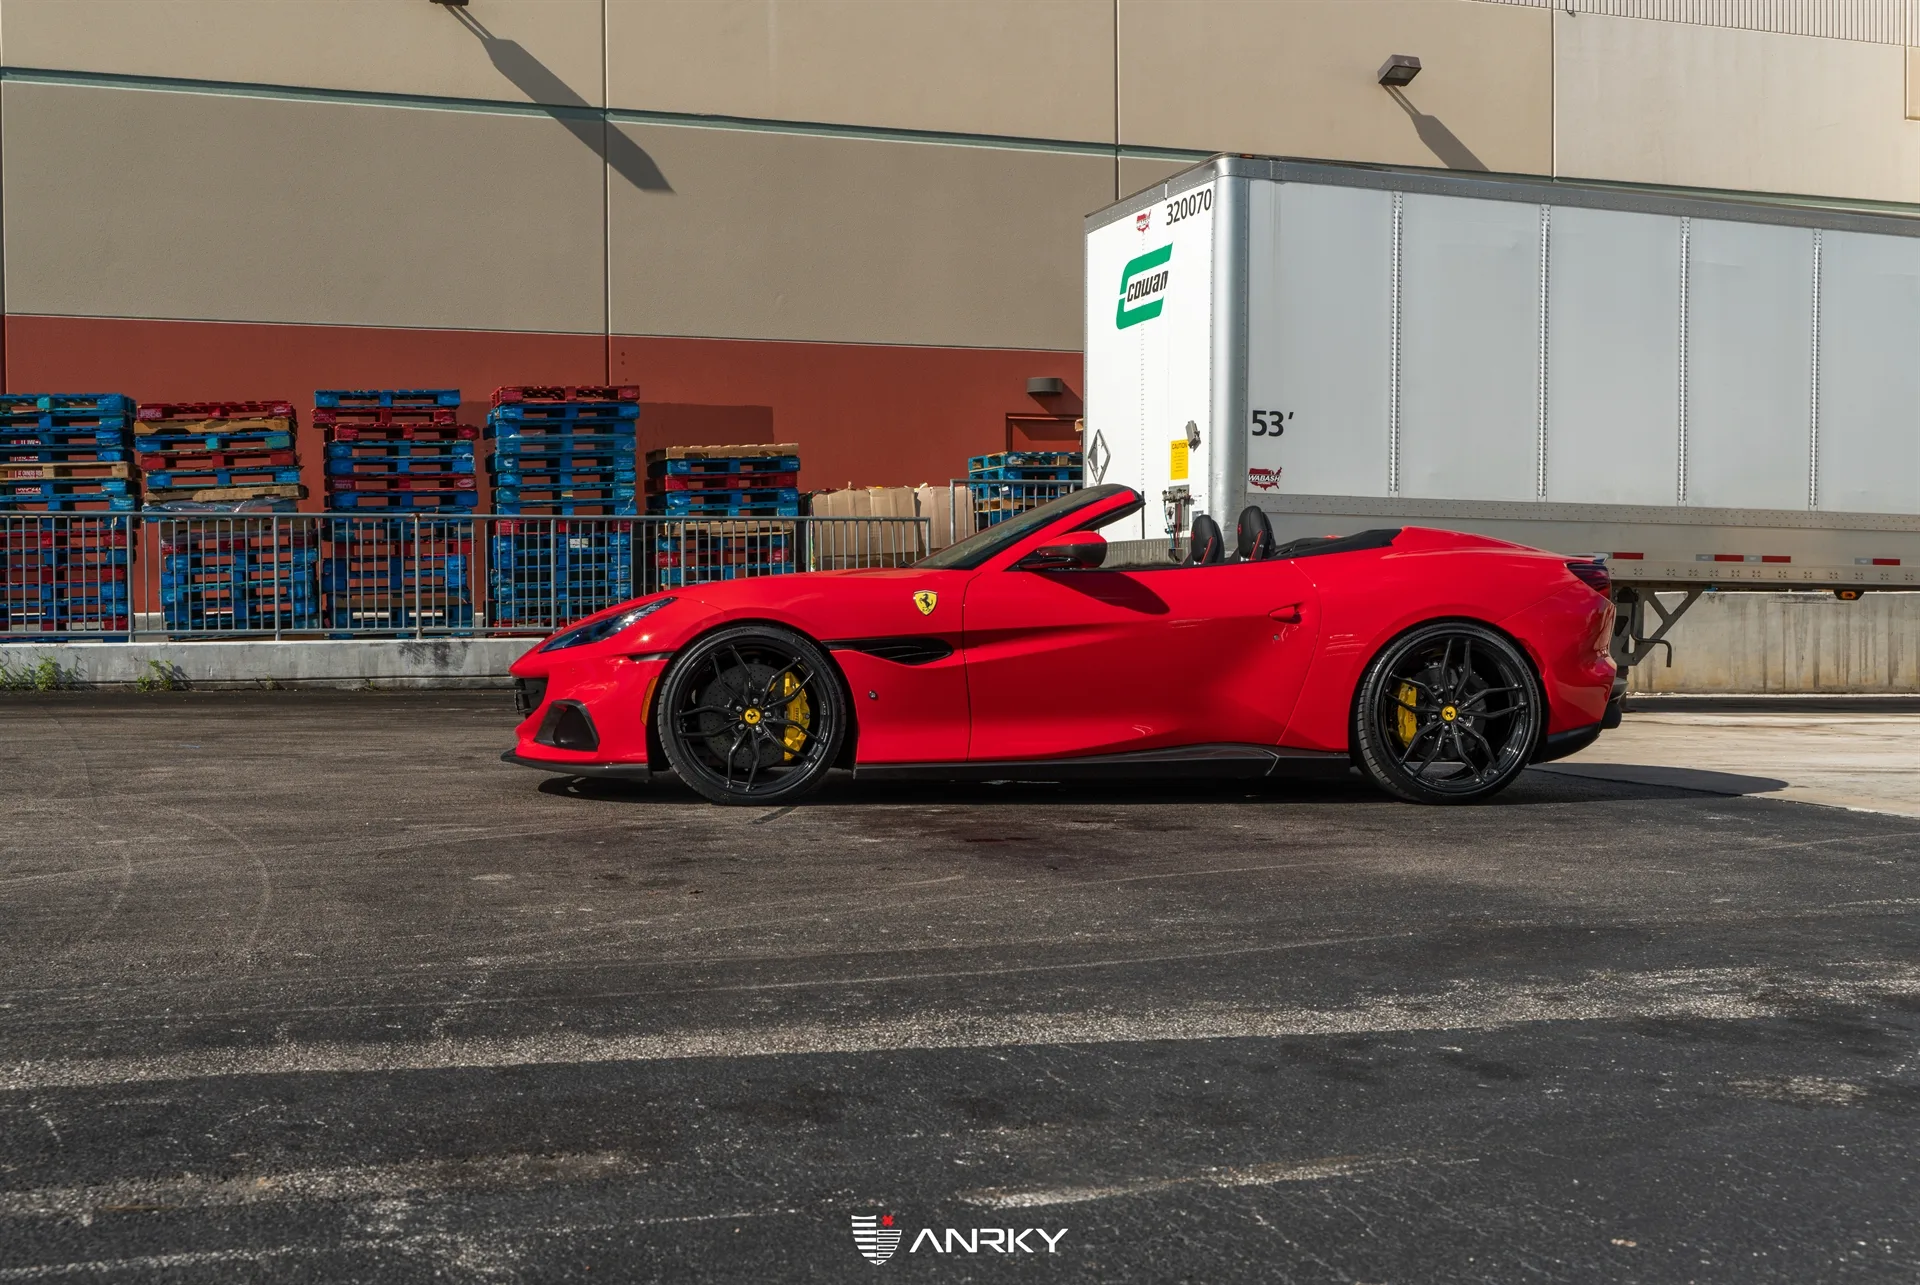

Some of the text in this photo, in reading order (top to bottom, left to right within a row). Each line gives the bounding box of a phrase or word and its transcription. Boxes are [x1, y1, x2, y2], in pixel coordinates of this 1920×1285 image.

[1166, 188, 1212, 226] 320070
[1171, 442, 1188, 450] CAUTION
[1248, 474, 1281, 482] WABASH
